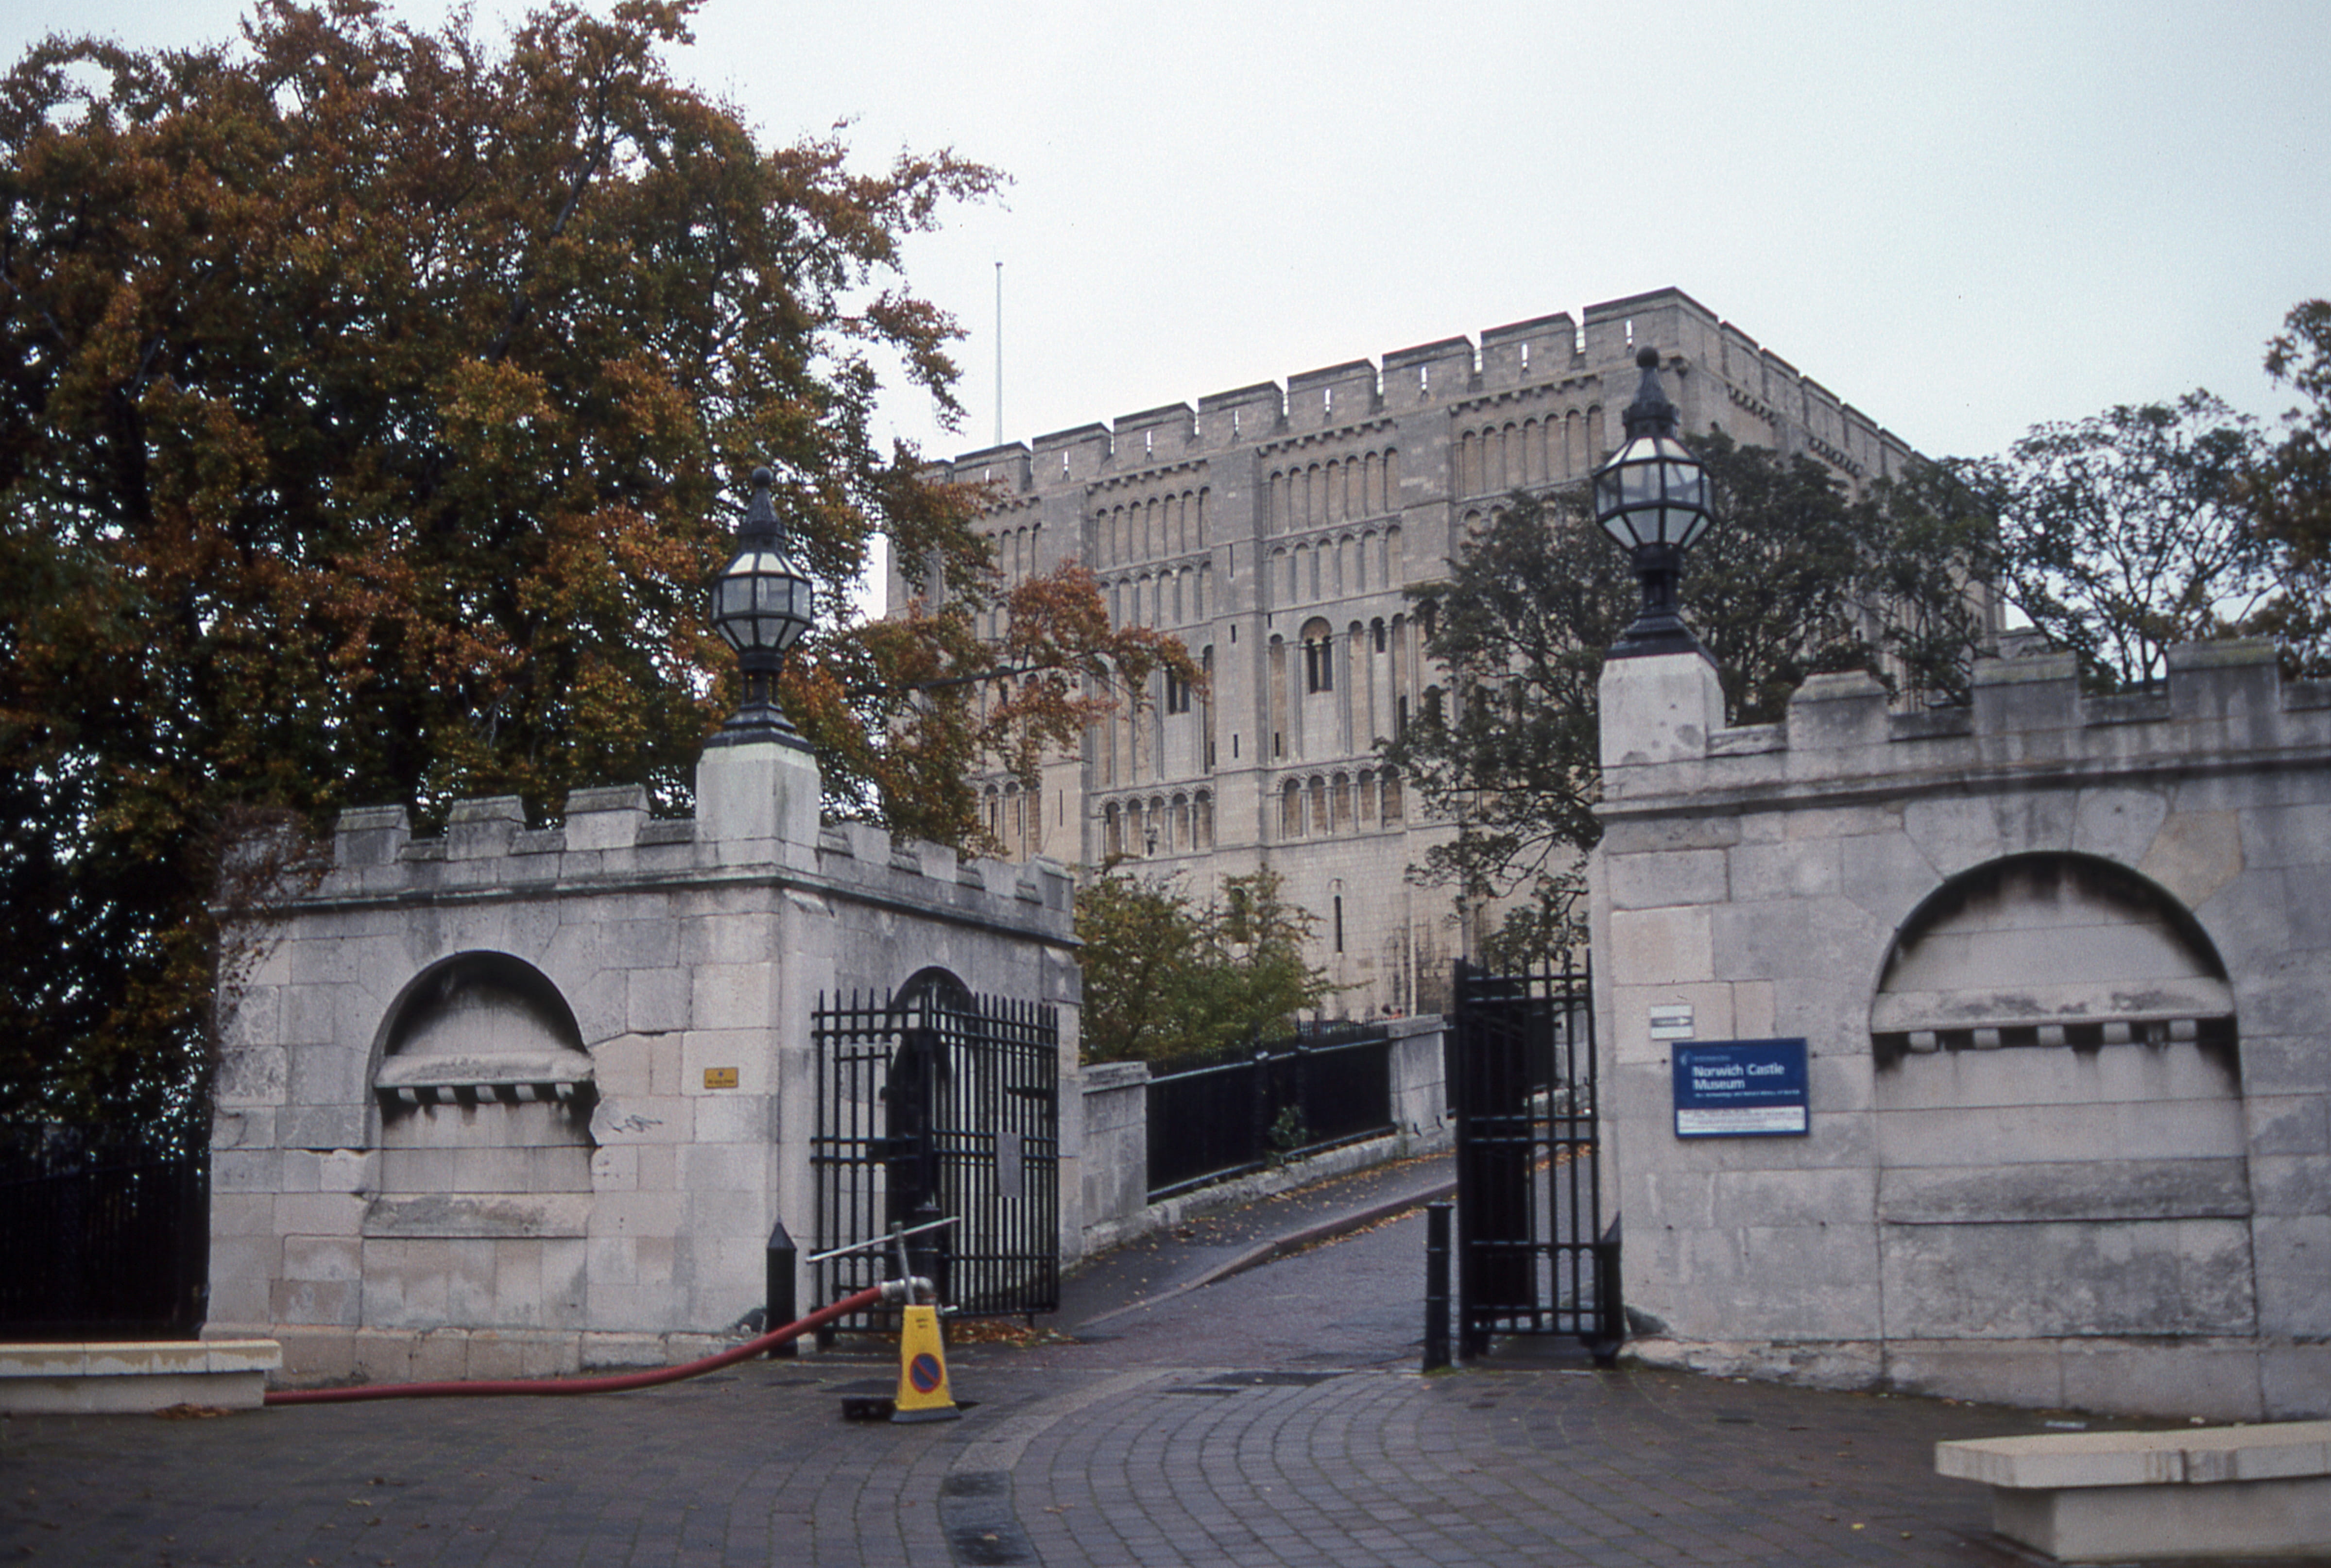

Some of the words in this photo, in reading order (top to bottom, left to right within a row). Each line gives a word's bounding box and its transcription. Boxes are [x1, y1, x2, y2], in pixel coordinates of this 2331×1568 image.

[1693, 1064, 1744, 1077] Norwich
[1747, 1062, 1785, 1075] Castle
[1693, 1079, 1745, 1090] Museum
